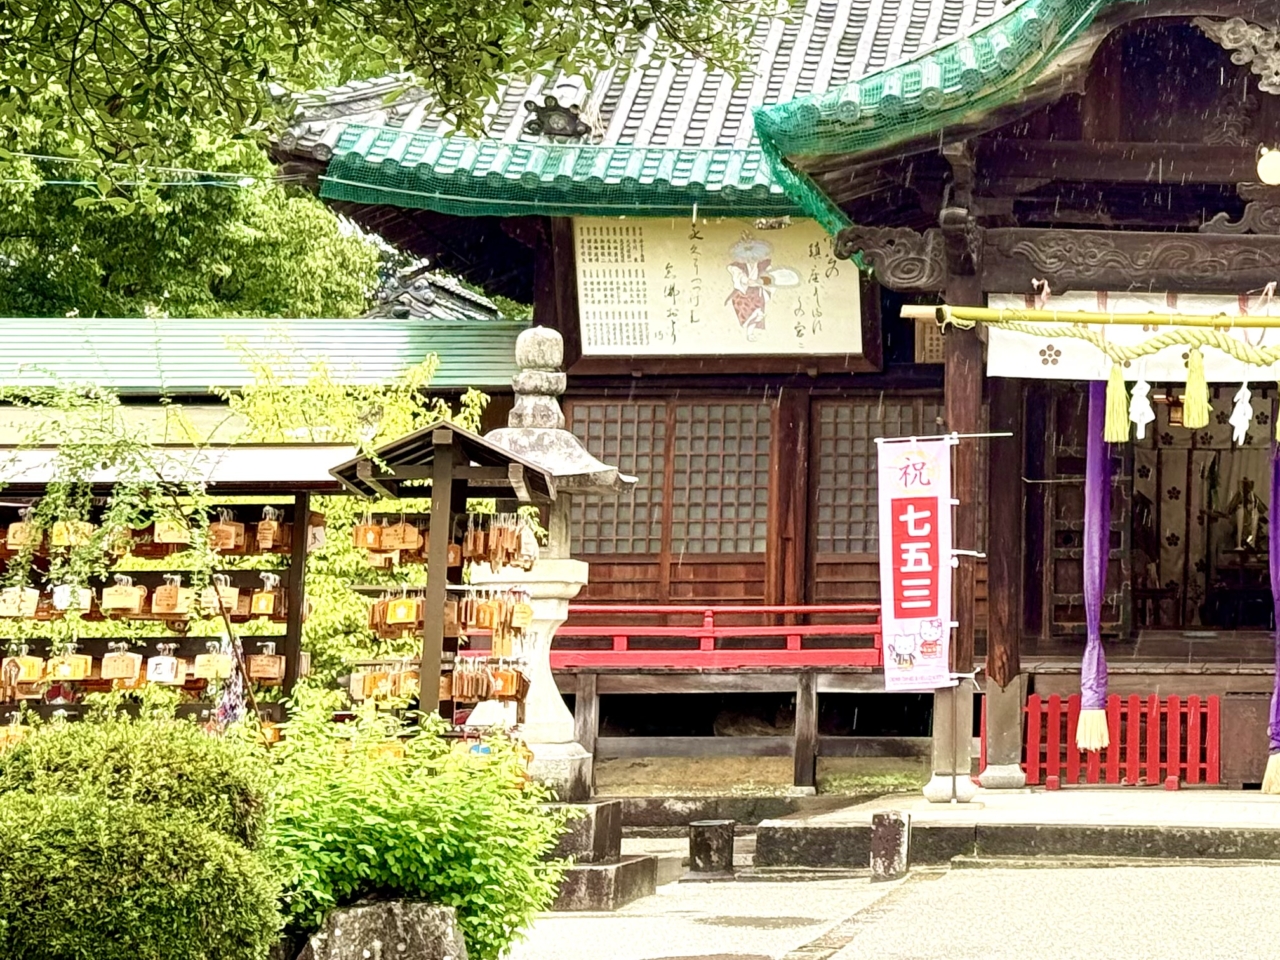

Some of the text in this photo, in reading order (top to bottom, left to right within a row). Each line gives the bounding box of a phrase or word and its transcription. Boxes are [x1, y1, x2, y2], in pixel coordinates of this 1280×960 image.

[898, 457, 932, 487] 祝
[899, 504, 933, 609] 七五三
